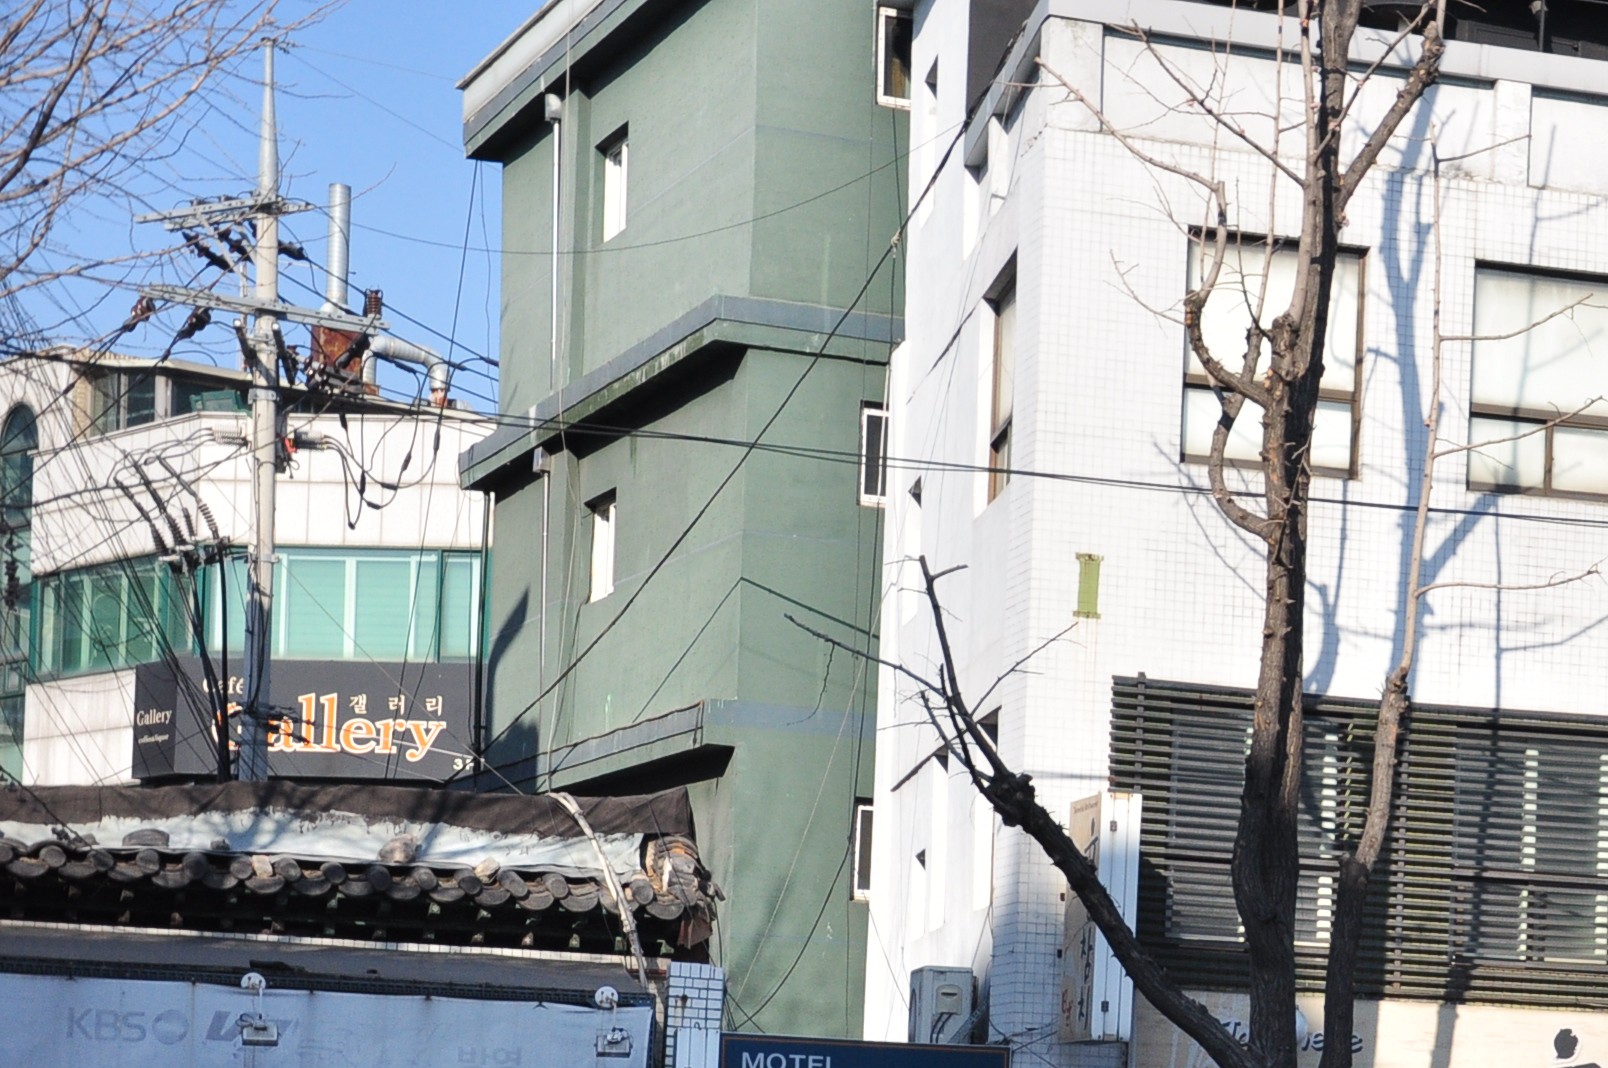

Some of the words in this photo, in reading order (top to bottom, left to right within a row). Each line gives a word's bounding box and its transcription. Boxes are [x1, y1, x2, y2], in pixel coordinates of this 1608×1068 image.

[350, 694, 443, 716] 갤러리
[136, 708, 172, 726] Gallery
[66, 1007, 147, 1042] KBS
